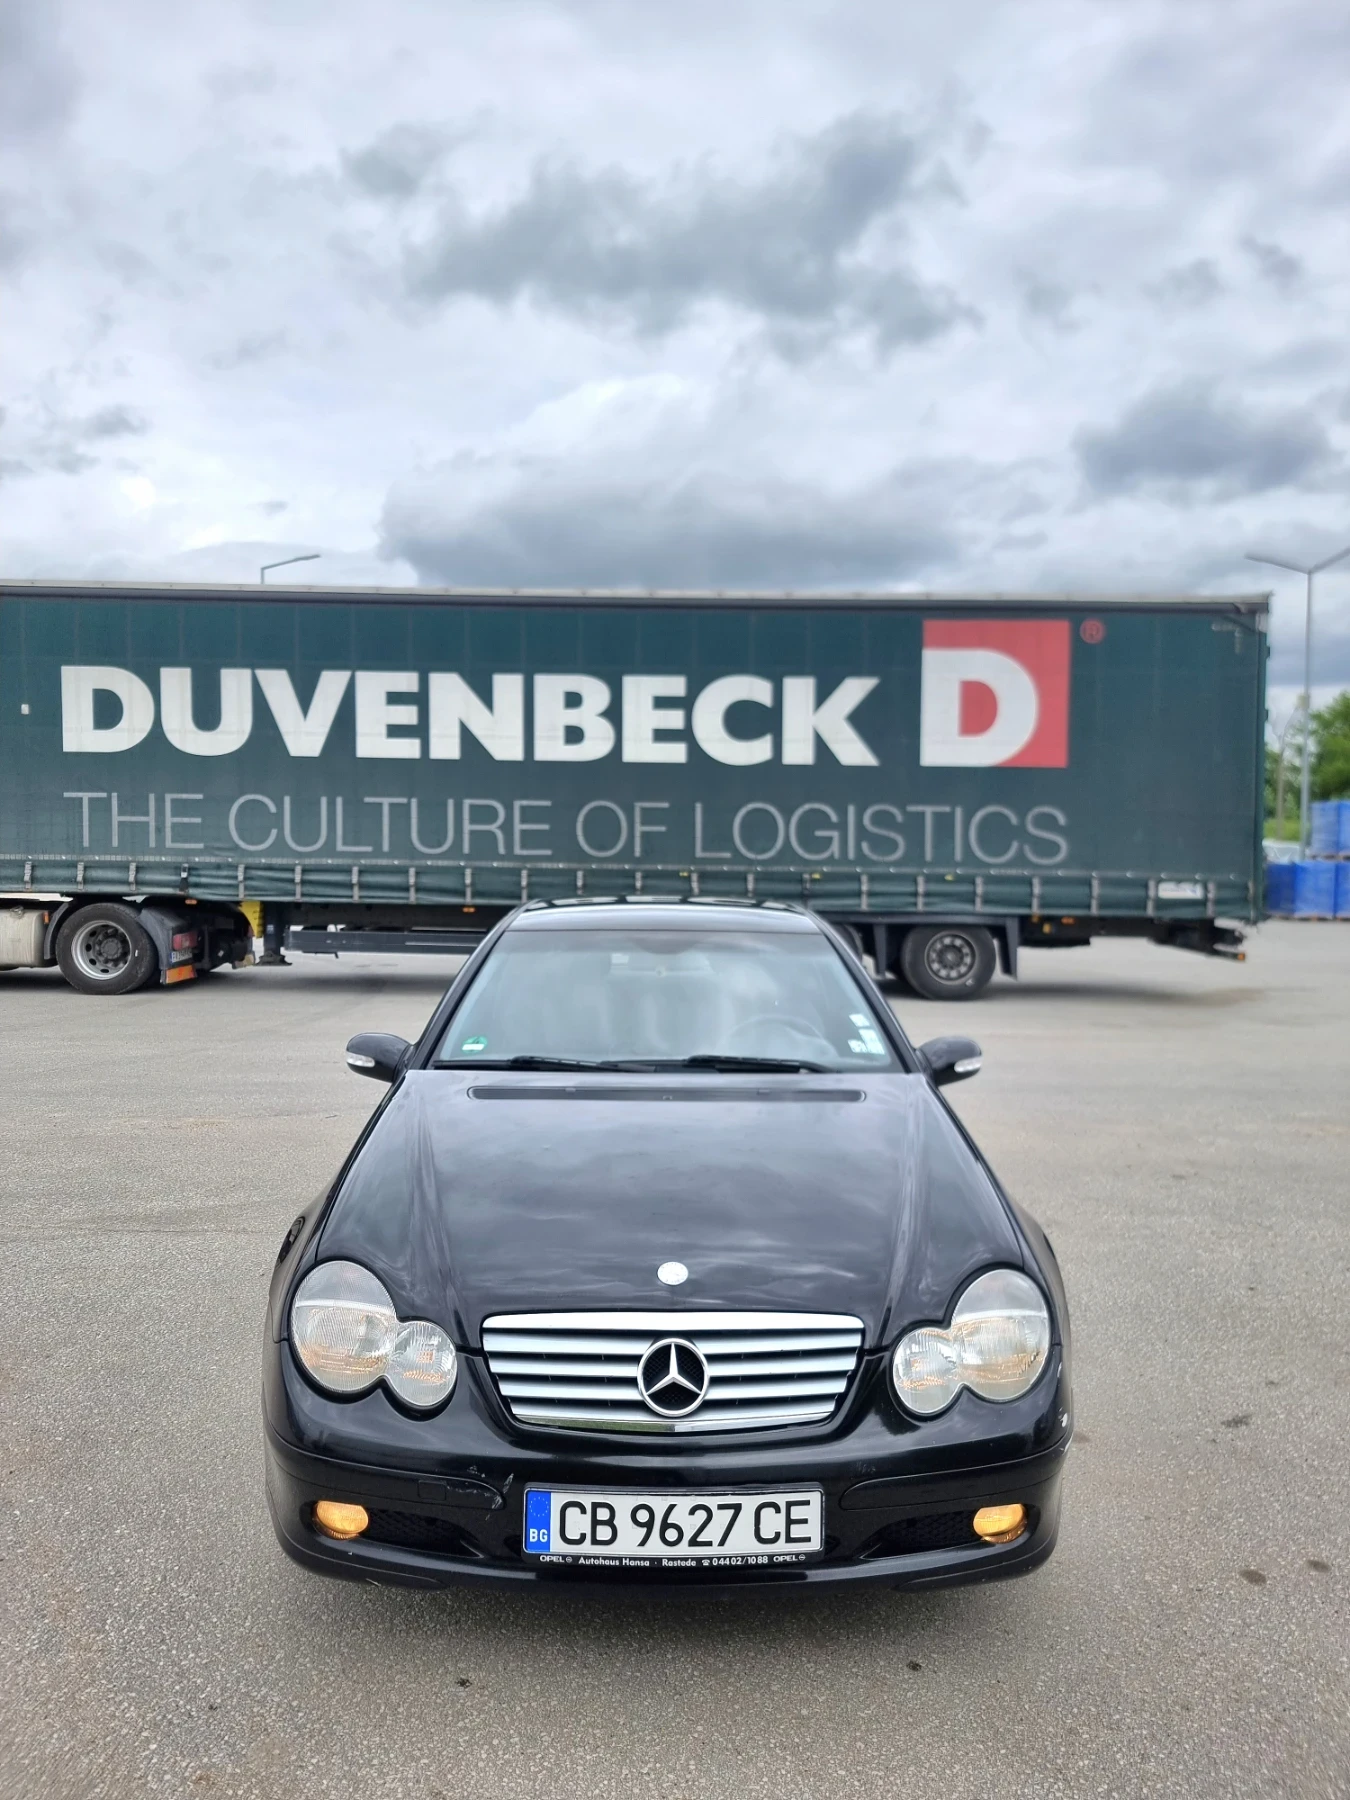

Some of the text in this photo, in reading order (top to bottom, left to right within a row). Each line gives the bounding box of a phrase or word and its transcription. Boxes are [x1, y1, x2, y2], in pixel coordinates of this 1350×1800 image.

[60, 665, 879, 767] DUVENBECK
[920, 649, 1038, 767] D
[63, 791, 1069, 866] THE CULTURE OF LOGISTICS
[529, 1528, 548, 1543] BG
[559, 1499, 812, 1547] CB 9627 CE
[539, 1554, 565, 1563] OPEL
[578, 1556, 620, 1566] Autohaus
[622, 1557, 650, 1567] Hansa
[661, 1558, 697, 1567] Rastede
[773, 1554, 798, 1563] OPEL
